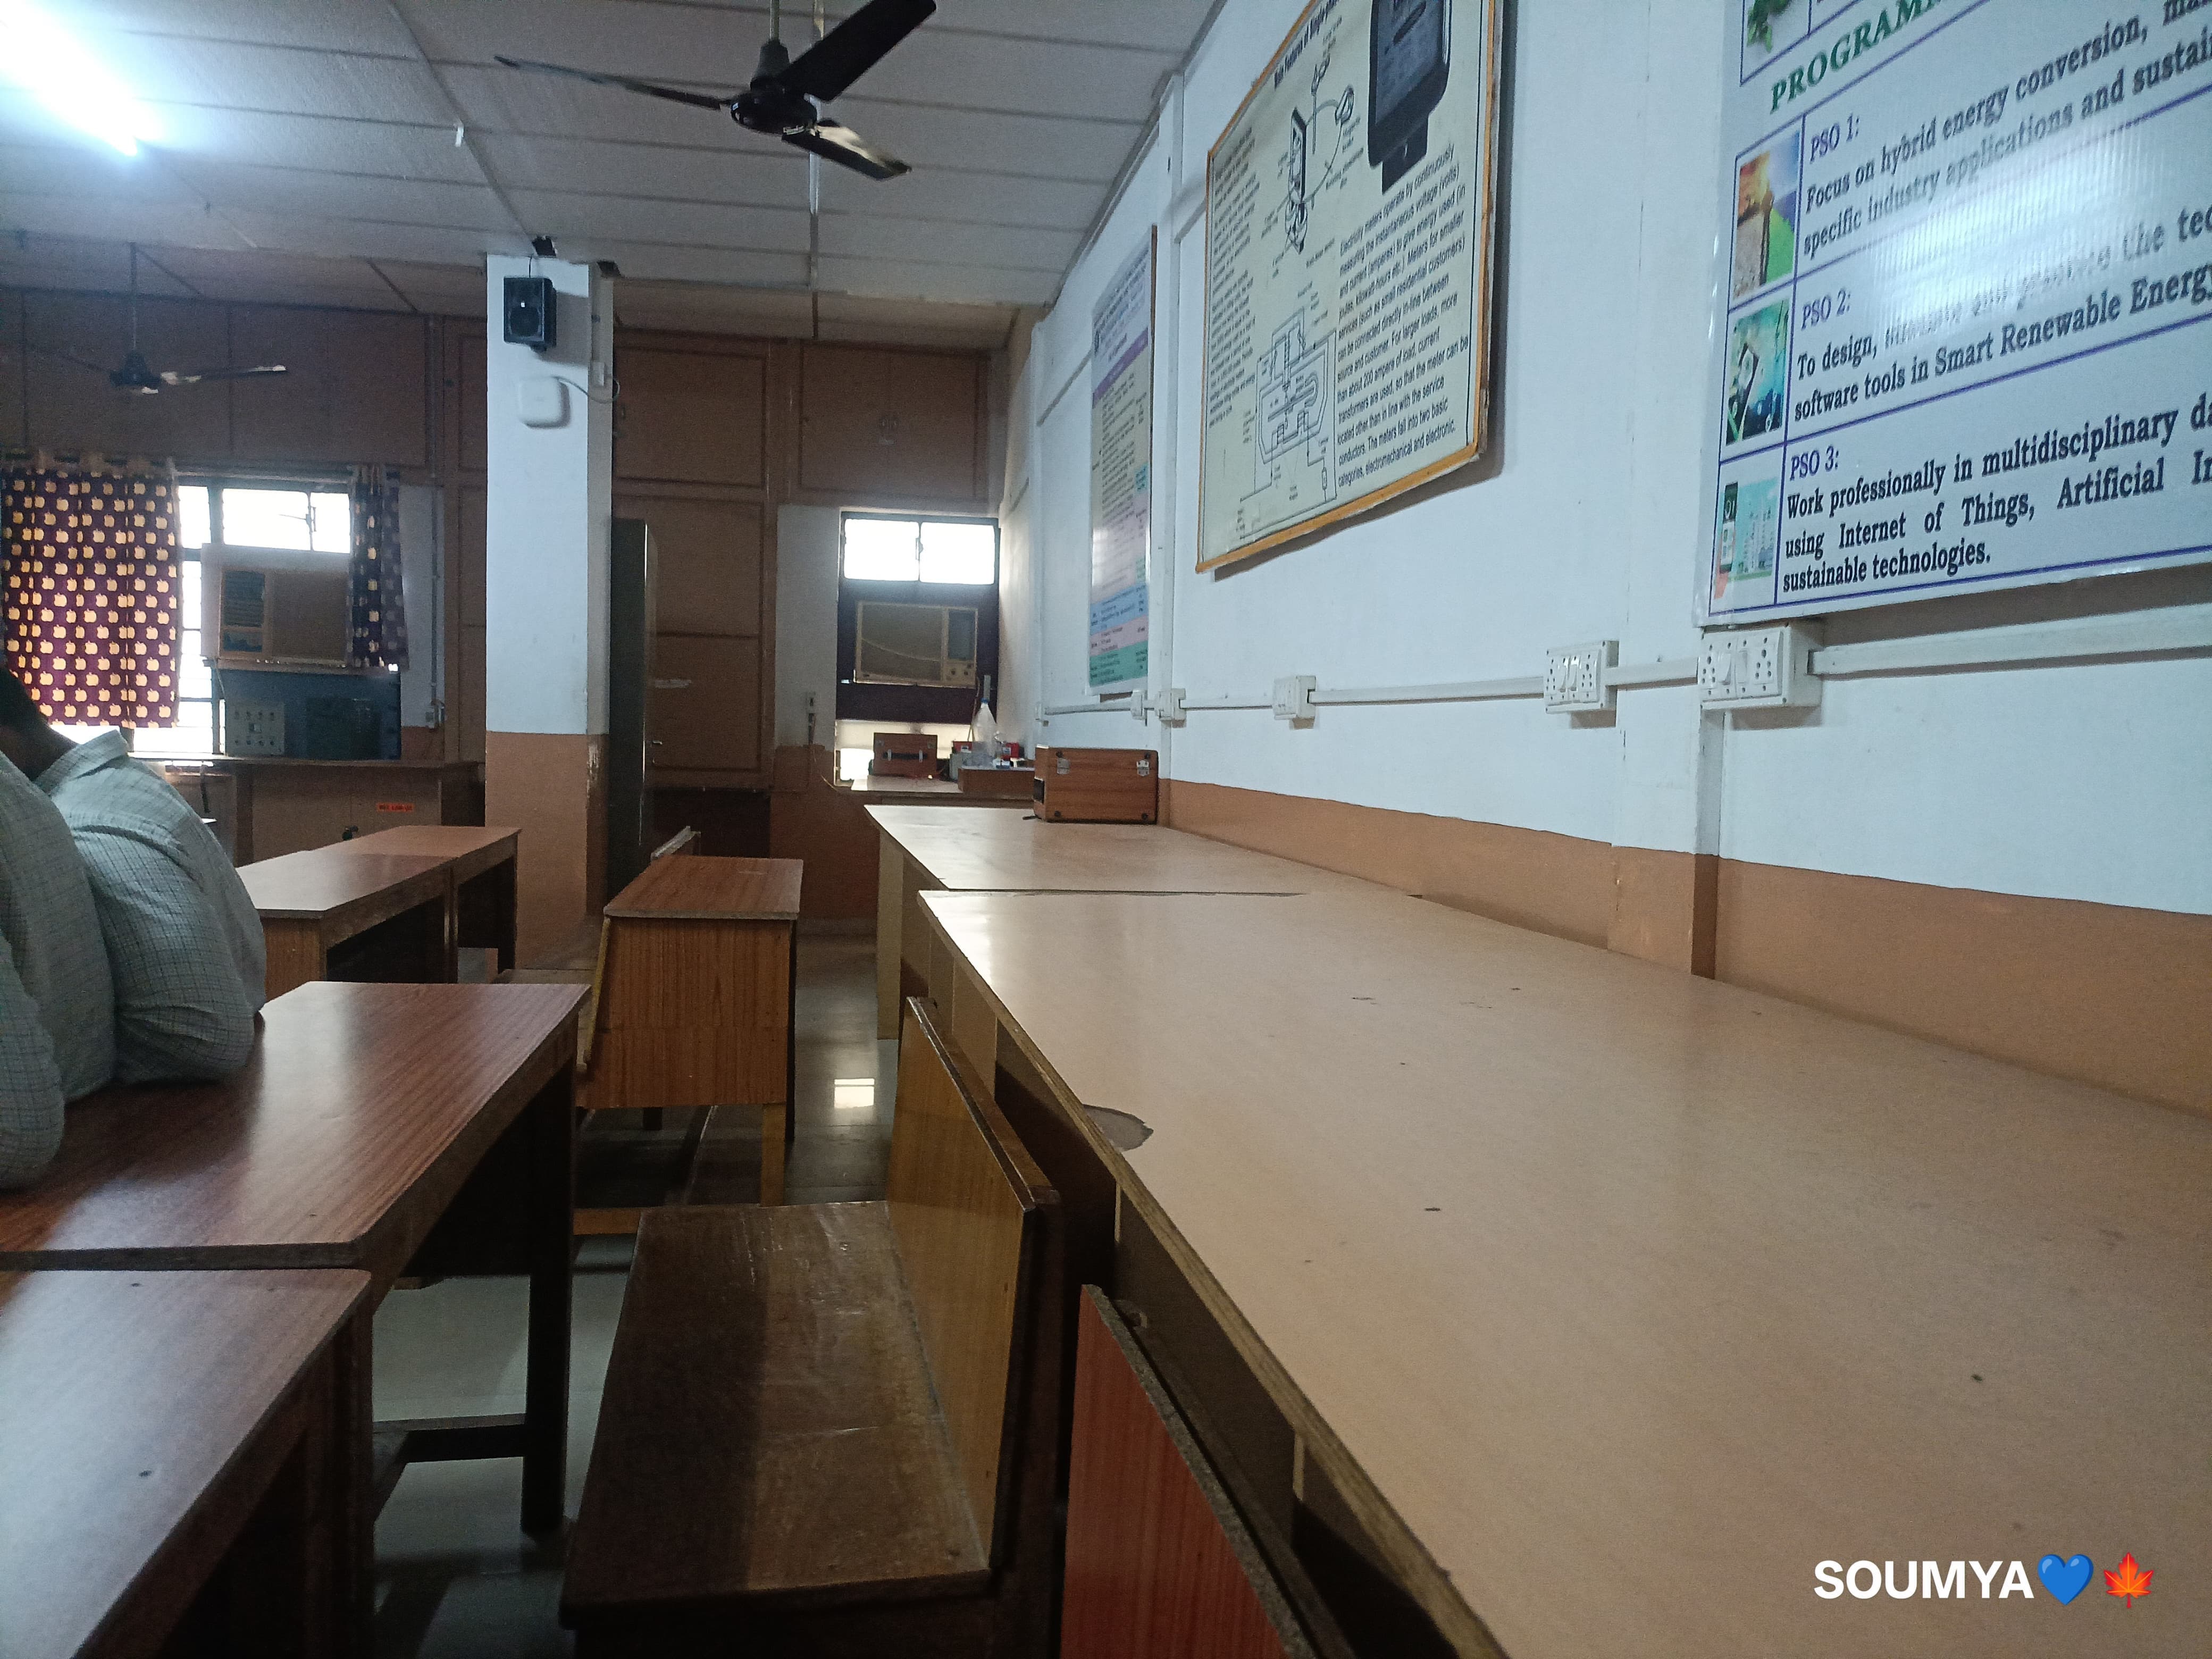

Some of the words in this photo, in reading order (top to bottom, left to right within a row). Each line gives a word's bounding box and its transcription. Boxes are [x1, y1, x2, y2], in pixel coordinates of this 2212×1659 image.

[1770, 0, 1941, 114] PROGRAM
[1804, 205, 1862, 260] specific
[1868, 169, 1940, 224] industry
[1946, 102, 2073, 186] applications
[2081, 66, 2124, 120] and
[2132, 24, 2212, 95] sustai
[1806, 172, 1850, 214] Focus
[1856, 159, 1874, 188] on
[1881, 115, 1936, 175] hybrid
[1942, 85, 2009, 140] energy
[2016, 15, 2148, 102] conversion,
[1810, 122, 1840, 164] PSO
[1846, 112, 1859, 143] 1:
[1384, 188, 1404, 219] operate
[1406, 181, 1413, 198] by
[1415, 143, 1454, 189] continuously
[1416, 183, 1438, 212] voltage
[1439, 162, 1459, 196] (volts)
[1404, 229, 1415, 251] give
[1417, 208, 1437, 236] energy
[1439, 190, 1454, 217] used
[1408, 239, 1428, 266] Meters
[1430, 231, 1438, 248] for
[1440, 210, 1464, 241] smaller
[1381, 284, 1395, 309] small
[1397, 261, 1427, 297] residential
[1429, 231, 1464, 274] customers)
[1797, 351, 1815, 381] To
[1822, 333, 1877, 372] design,
[2122, 222, 2165, 261] the
[1801, 295, 1832, 331] PSO
[1837, 287, 1851, 317] 2:
[1337, 365, 1353, 383] source
[1354, 355, 1363, 373] and
[1392, 330, 1401, 346] For
[1403, 319, 1420, 339] larger
[1441, 292, 1457, 313] more
[1355, 320, 1380, 350] connected
[1381, 306, 1401, 331] directly
[1422, 272, 1449, 303] between
[1337, 388, 1347, 404] than
[1349, 377, 1362, 397] about
[1364, 370, 1373, 388] 200
[1375, 358, 1394, 381] ampere
[1396, 350, 1402, 368] of
[1418, 326, 1439, 353] current
[1338, 396, 1368, 424] transformers
[1396, 378, 1402, 390] so
[1404, 366, 1414, 385] that
[1417, 362, 1426, 378] the
[1427, 349, 1445, 372] meter
[1446, 342, 1458, 361] can
[1460, 334, 1468, 351] be
[1795, 382, 1859, 422] software
[1864, 361, 1905, 399] tools
[1911, 355, 1929, 386] in
[1934, 332, 1994, 376] Smart
[2000, 287, 2121, 357] Renewable
[1337, 424, 1354, 445] located
[1356, 420, 1368, 436] other
[1369, 412, 1380, 428] than
[1382, 409, 1387, 421] in
[1388, 402, 1397, 418] line
[1400, 394, 1410, 410] with
[1412, 388, 1421, 404] the
[1423, 375, 1444, 398] service
[1365, 439, 1412, 474] electromechanical
[1414, 432, 1424, 452] and
[1426, 418, 1455, 446] electronic.
[1368, 435, 1377, 451] The
[1379, 427, 1396, 446] meters
[1407, 415, 1418, 431] into
[1420, 408, 1430, 424] two
[1431, 397, 1448, 418] basic
[1787, 487, 1824, 520] Work
[1829, 458, 1946, 518] professionally
[1953, 451, 1973, 483] in
[1982, 409, 2179, 477] multidisciplinary
[1790, 449, 1820, 482] PSO
[1824, 445, 1839, 472] 3:
[1786, 531, 1824, 560] using
[1839, 511, 1906, 549] Internet
[1924, 501, 1945, 533] of
[1962, 490, 2035, 527] Things,
[2057, 456, 2165, 509] Artificial
[1783, 556, 1867, 592] sustainable
[1872, 537, 1991, 576] technologies.
